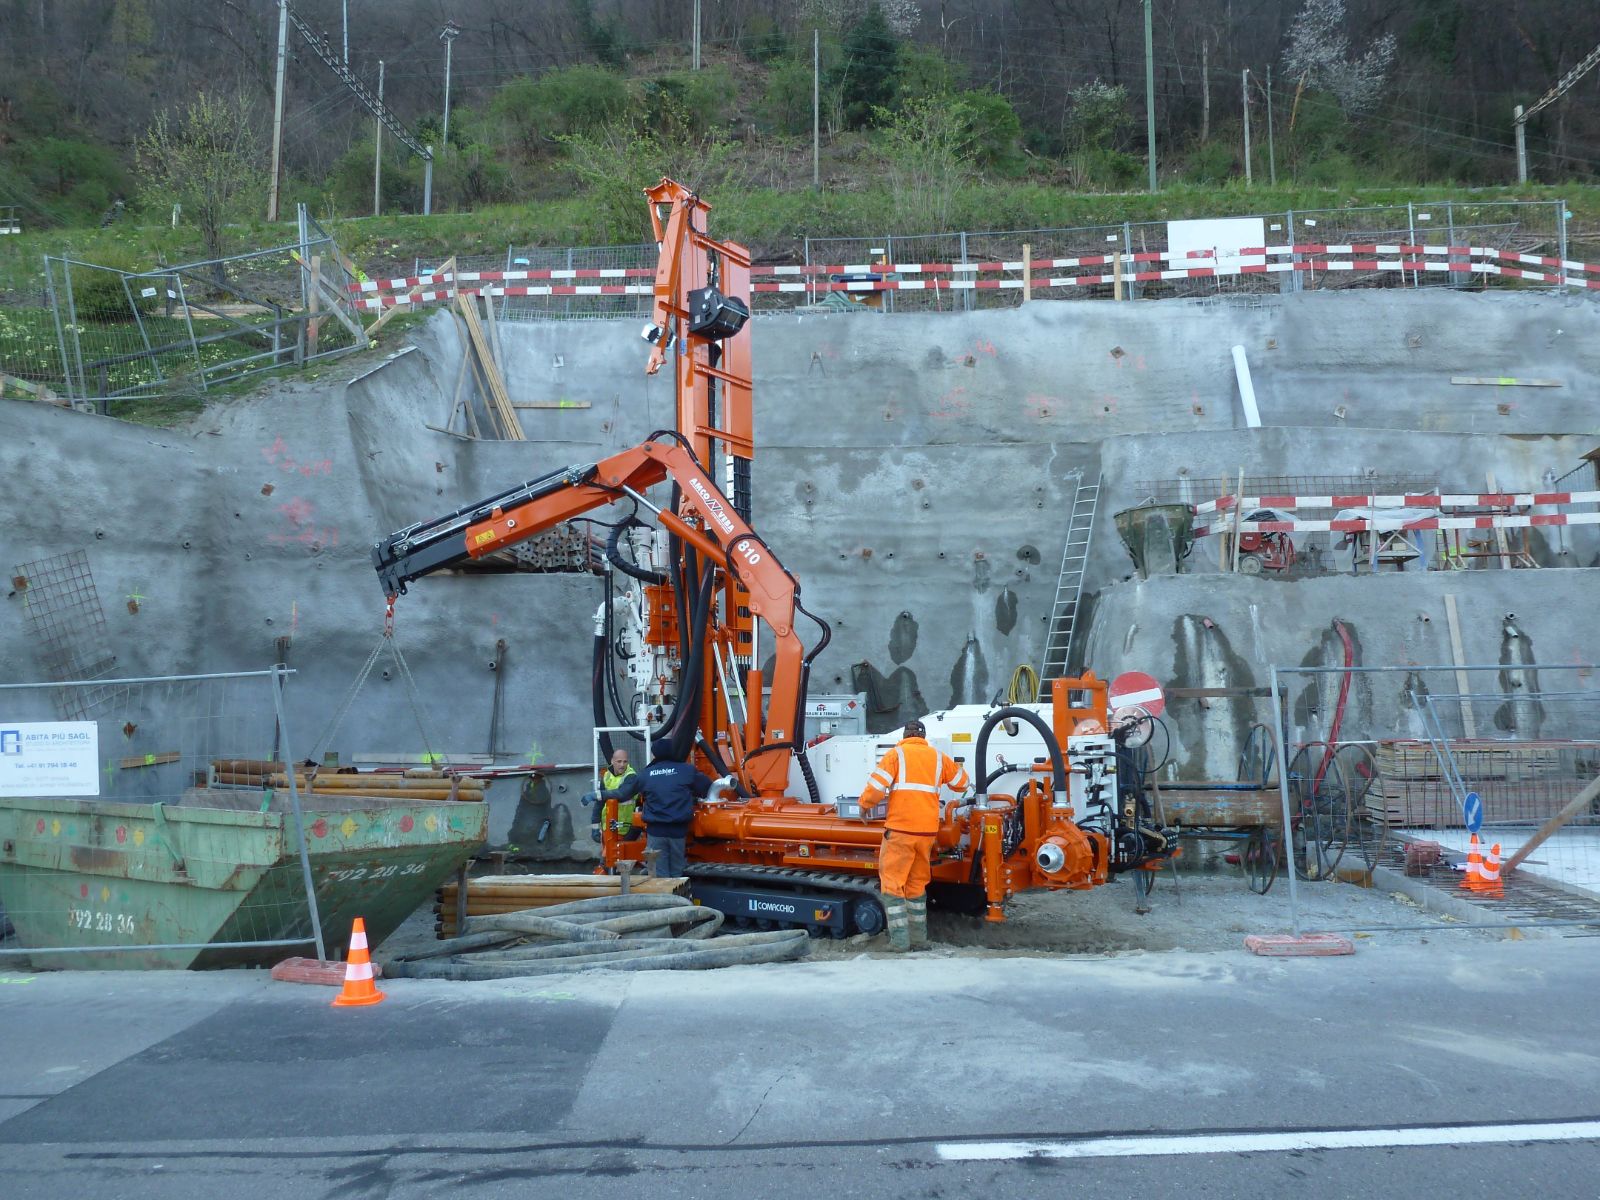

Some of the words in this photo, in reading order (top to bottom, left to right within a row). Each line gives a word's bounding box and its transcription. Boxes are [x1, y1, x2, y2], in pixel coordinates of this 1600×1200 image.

[689, 478, 711, 500] AMCO
[717, 510, 735, 533] VEBA
[737, 540, 761, 565] 810
[25, 733, 50, 741] ABITA
[67, 731, 91, 740] SAGL
[758, 901, 795, 913] COMACCHIO
[95, 911, 113, 932] 28
